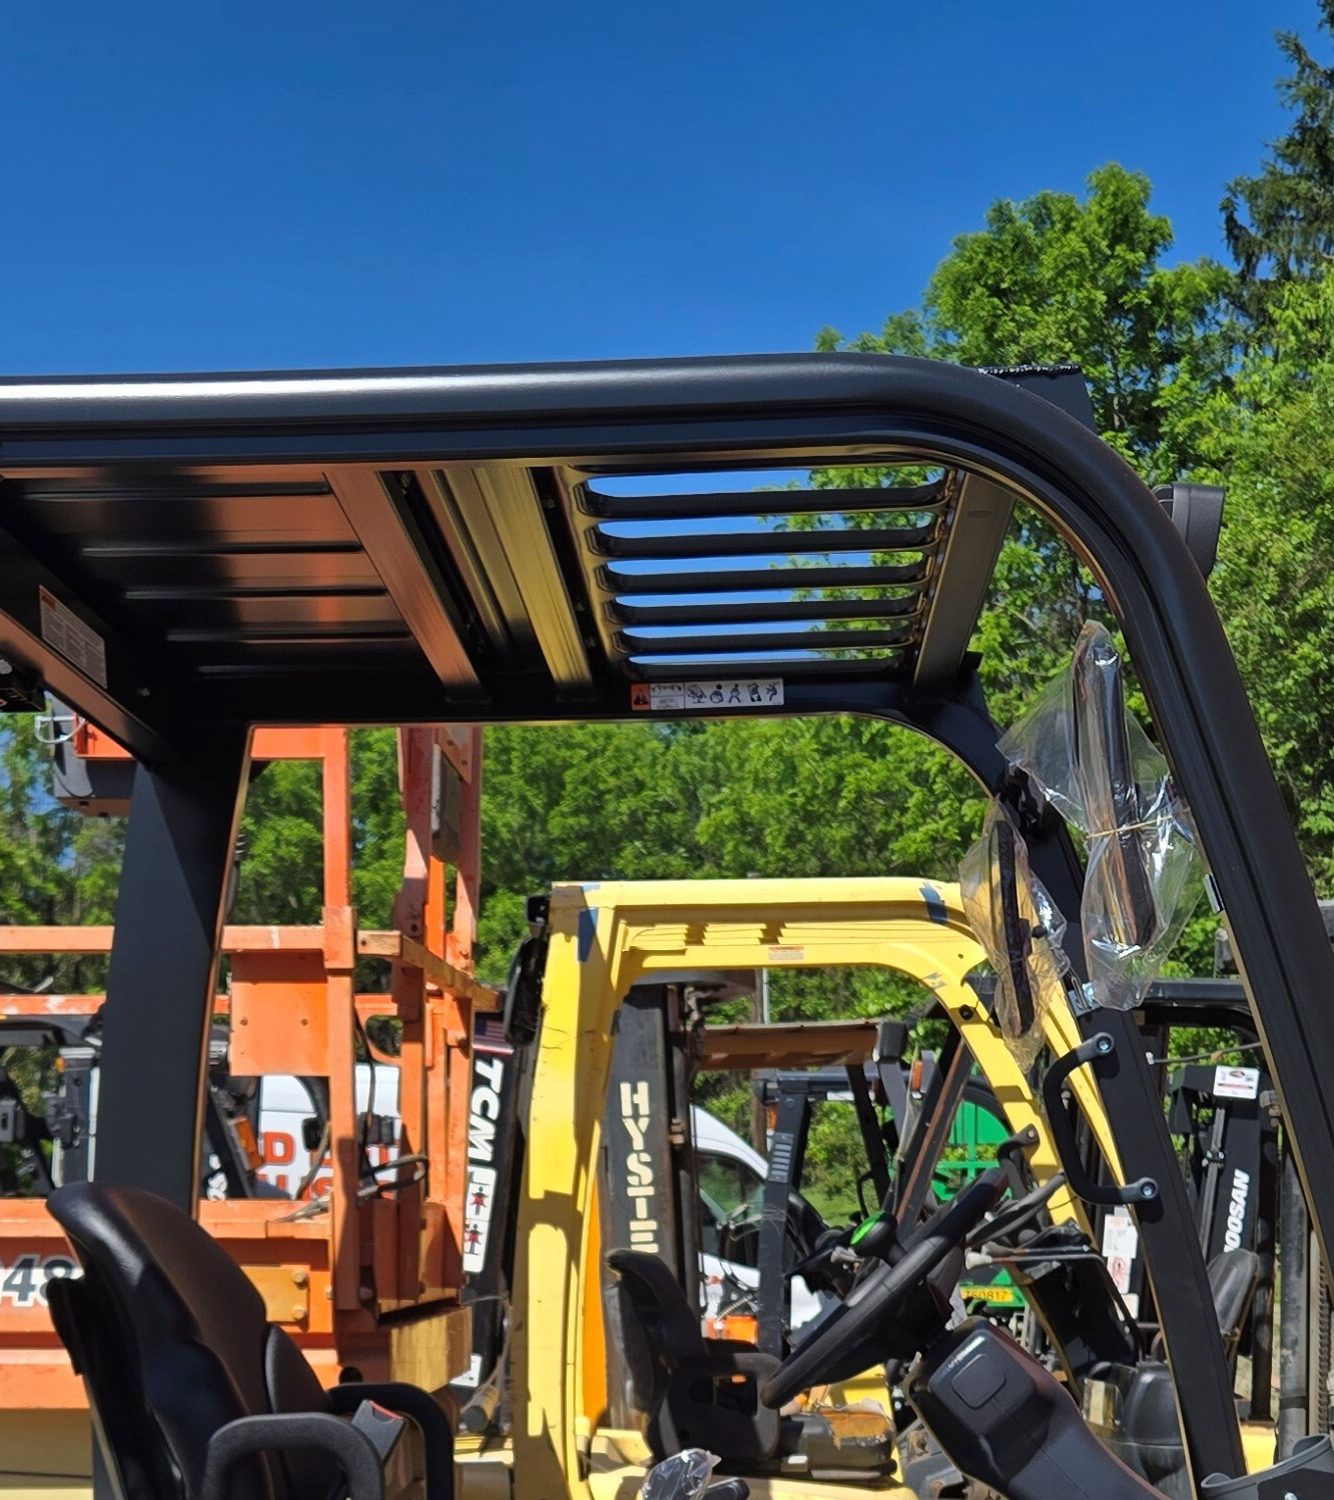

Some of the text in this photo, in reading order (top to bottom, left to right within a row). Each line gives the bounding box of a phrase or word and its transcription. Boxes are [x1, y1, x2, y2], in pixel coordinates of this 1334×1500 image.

[467, 1057, 504, 1162] TCM
[619, 1081, 660, 1254] HYSTE
[1224, 1168, 1251, 1255] OOSAN
